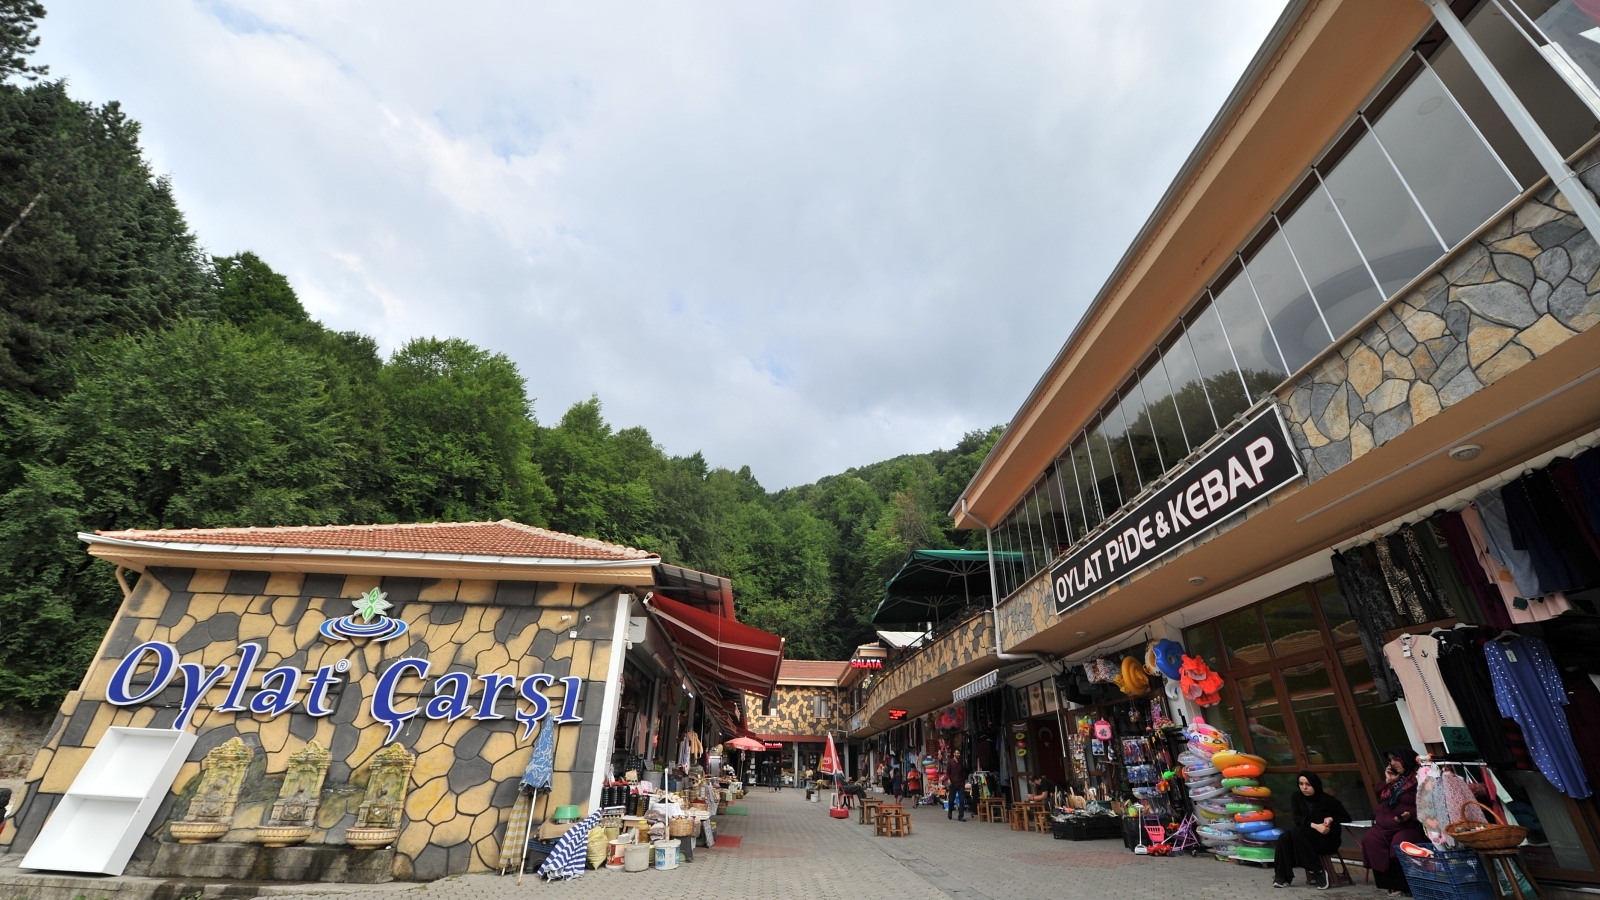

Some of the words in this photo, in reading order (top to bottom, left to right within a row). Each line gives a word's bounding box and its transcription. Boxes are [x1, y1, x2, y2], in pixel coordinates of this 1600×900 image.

[1056, 549, 1102, 603] OYLAT
[1155, 510, 1171, 538] &
[1167, 436, 1275, 533] KEBAP
[370, 657, 584, 746] Çarşı
[851, 658, 883, 669] SALATA
